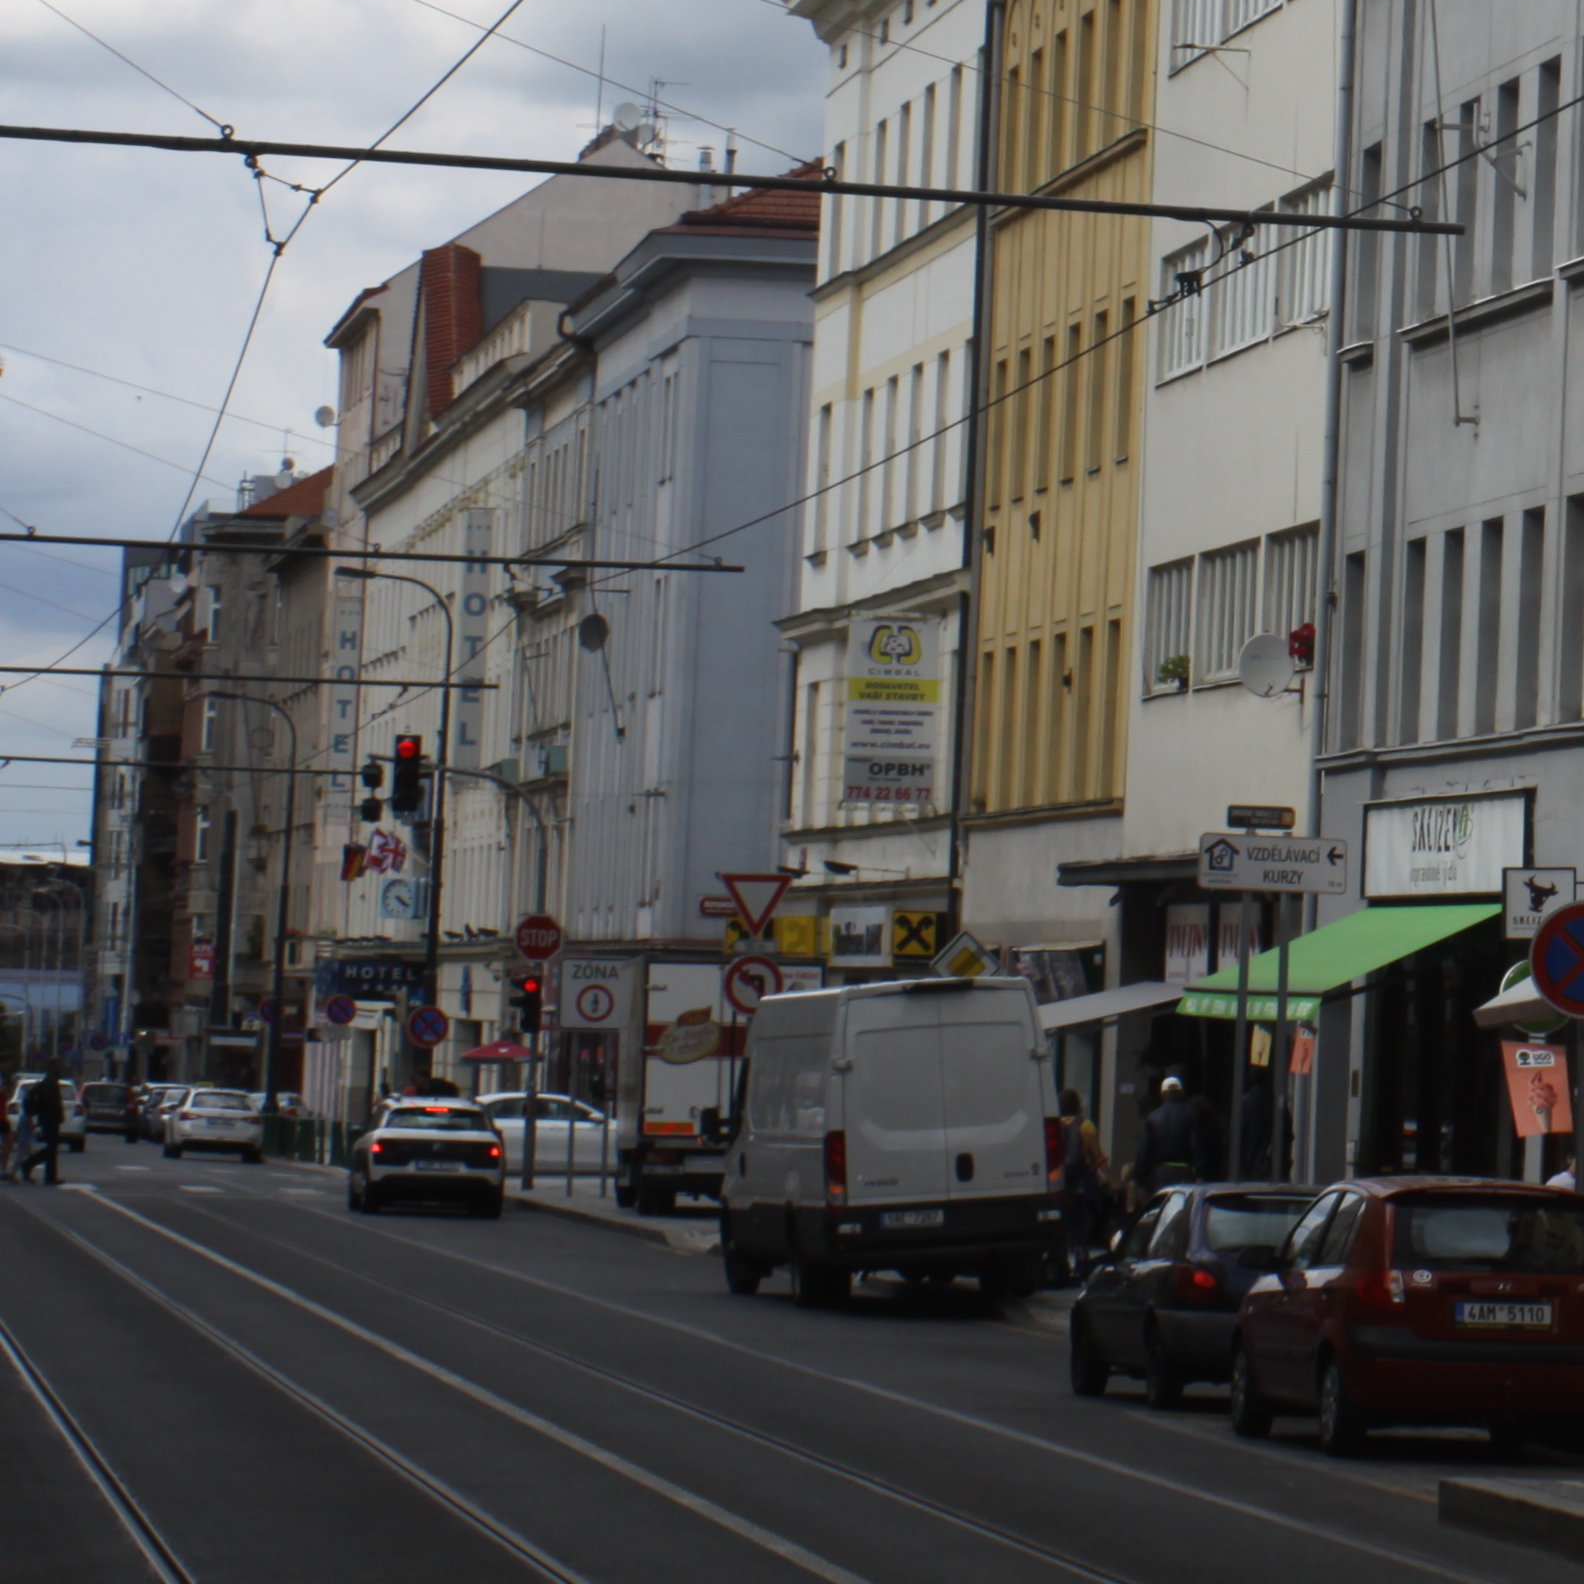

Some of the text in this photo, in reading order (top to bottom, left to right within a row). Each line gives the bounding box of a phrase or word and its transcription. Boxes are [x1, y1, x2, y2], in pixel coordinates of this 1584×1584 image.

[459, 549, 487, 747] HOTEL
[331, 630, 356, 788] HOTEL
[1246, 846, 1321, 864] VZDĚLÁVACÍ
[1262, 870, 1304, 885] KURZY
[520, 928, 557, 947] STOP
[346, 966, 416, 982] HOTEL
[572, 961, 619, 980] ZÓNA
[1467, 1305, 1545, 1323] 4AM 5110
